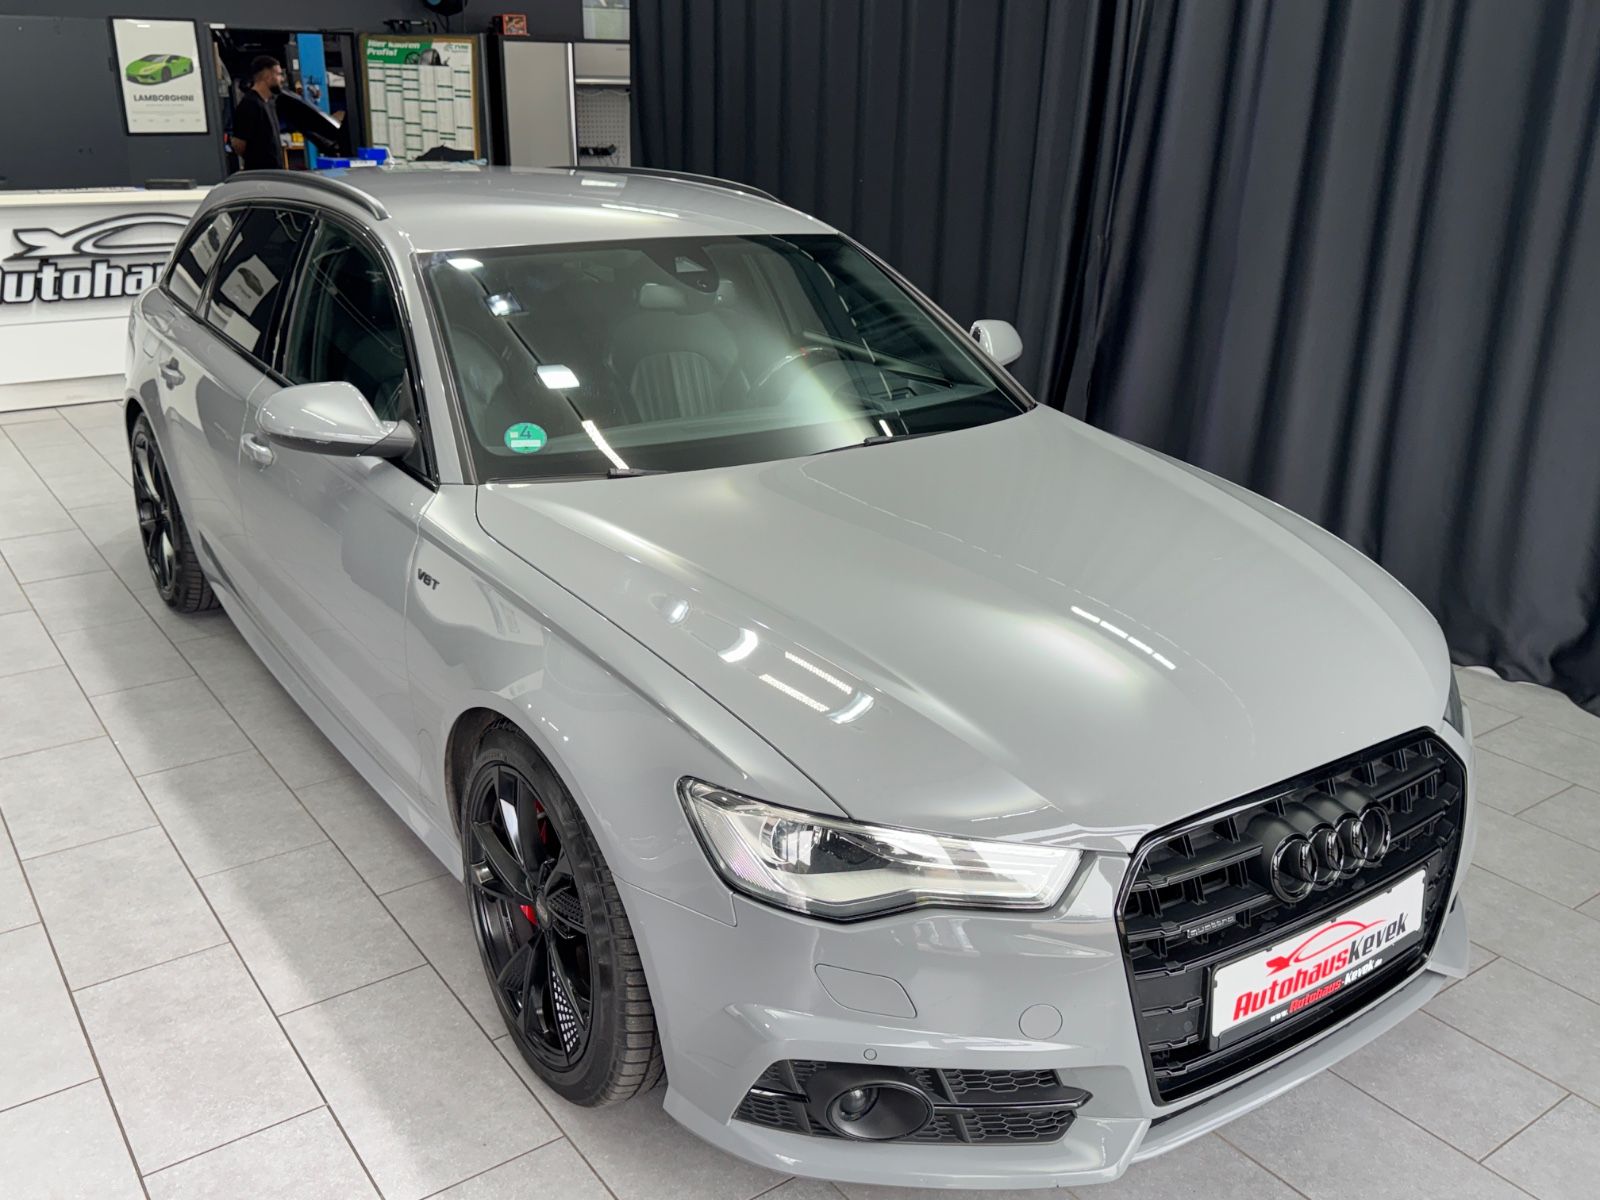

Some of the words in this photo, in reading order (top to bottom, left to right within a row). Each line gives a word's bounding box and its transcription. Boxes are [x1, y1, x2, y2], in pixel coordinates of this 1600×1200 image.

[133, 94, 194, 102] LAMBORGHINI
[0, 259, 165, 304] utoha
[519, 425, 532, 440] 4
[417, 567, 440, 590] V6T
